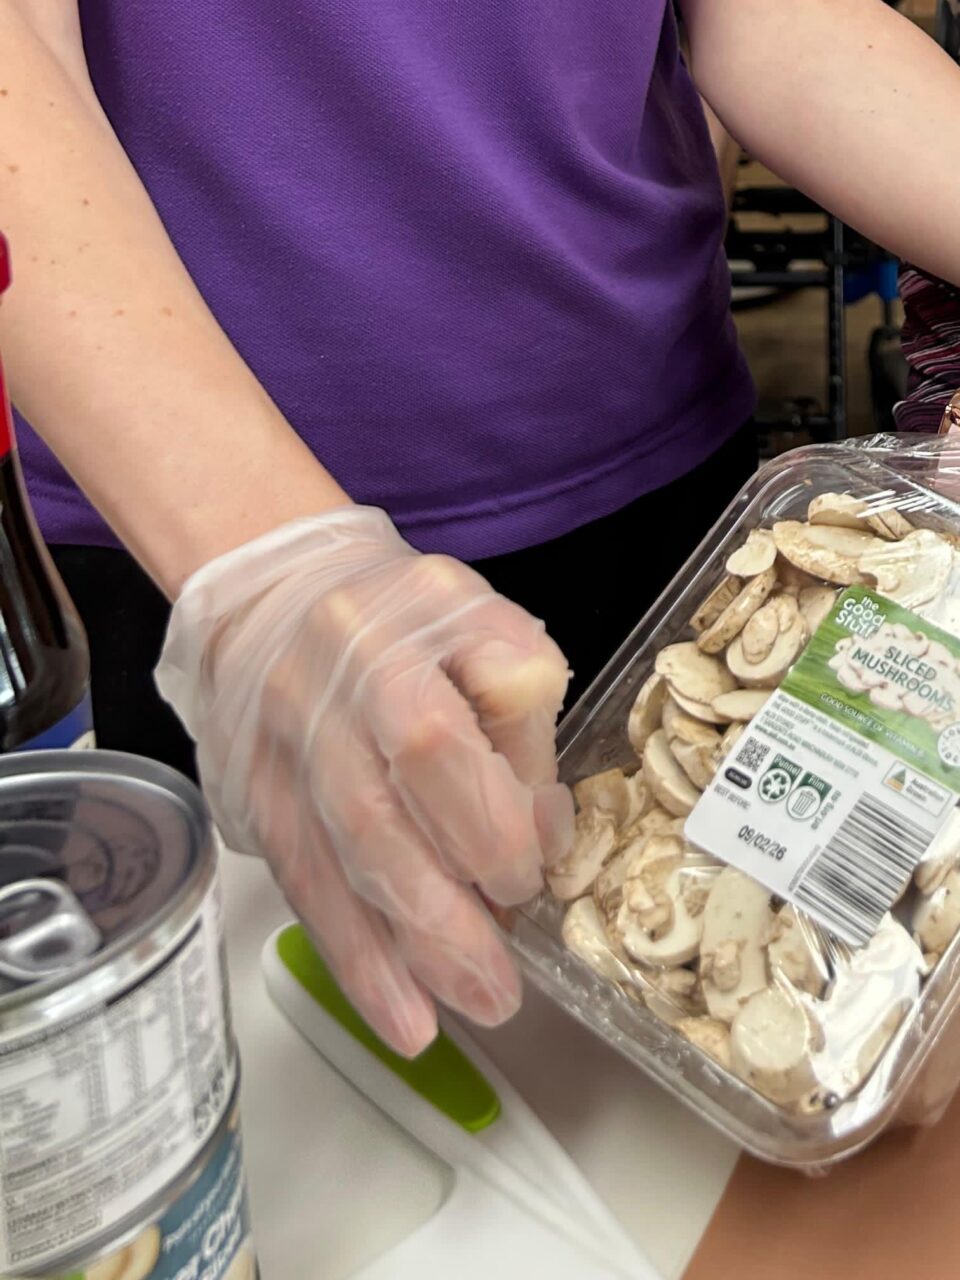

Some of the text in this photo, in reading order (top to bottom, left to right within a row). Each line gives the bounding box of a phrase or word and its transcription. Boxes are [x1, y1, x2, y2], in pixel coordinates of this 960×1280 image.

[861, 596, 880, 611] the
[851, 647, 956, 712] MUSHROOMS
[883, 645, 938, 681] SLICED
[807, 775, 826, 792] Film
[738, 824, 788, 862] 09/02/26
